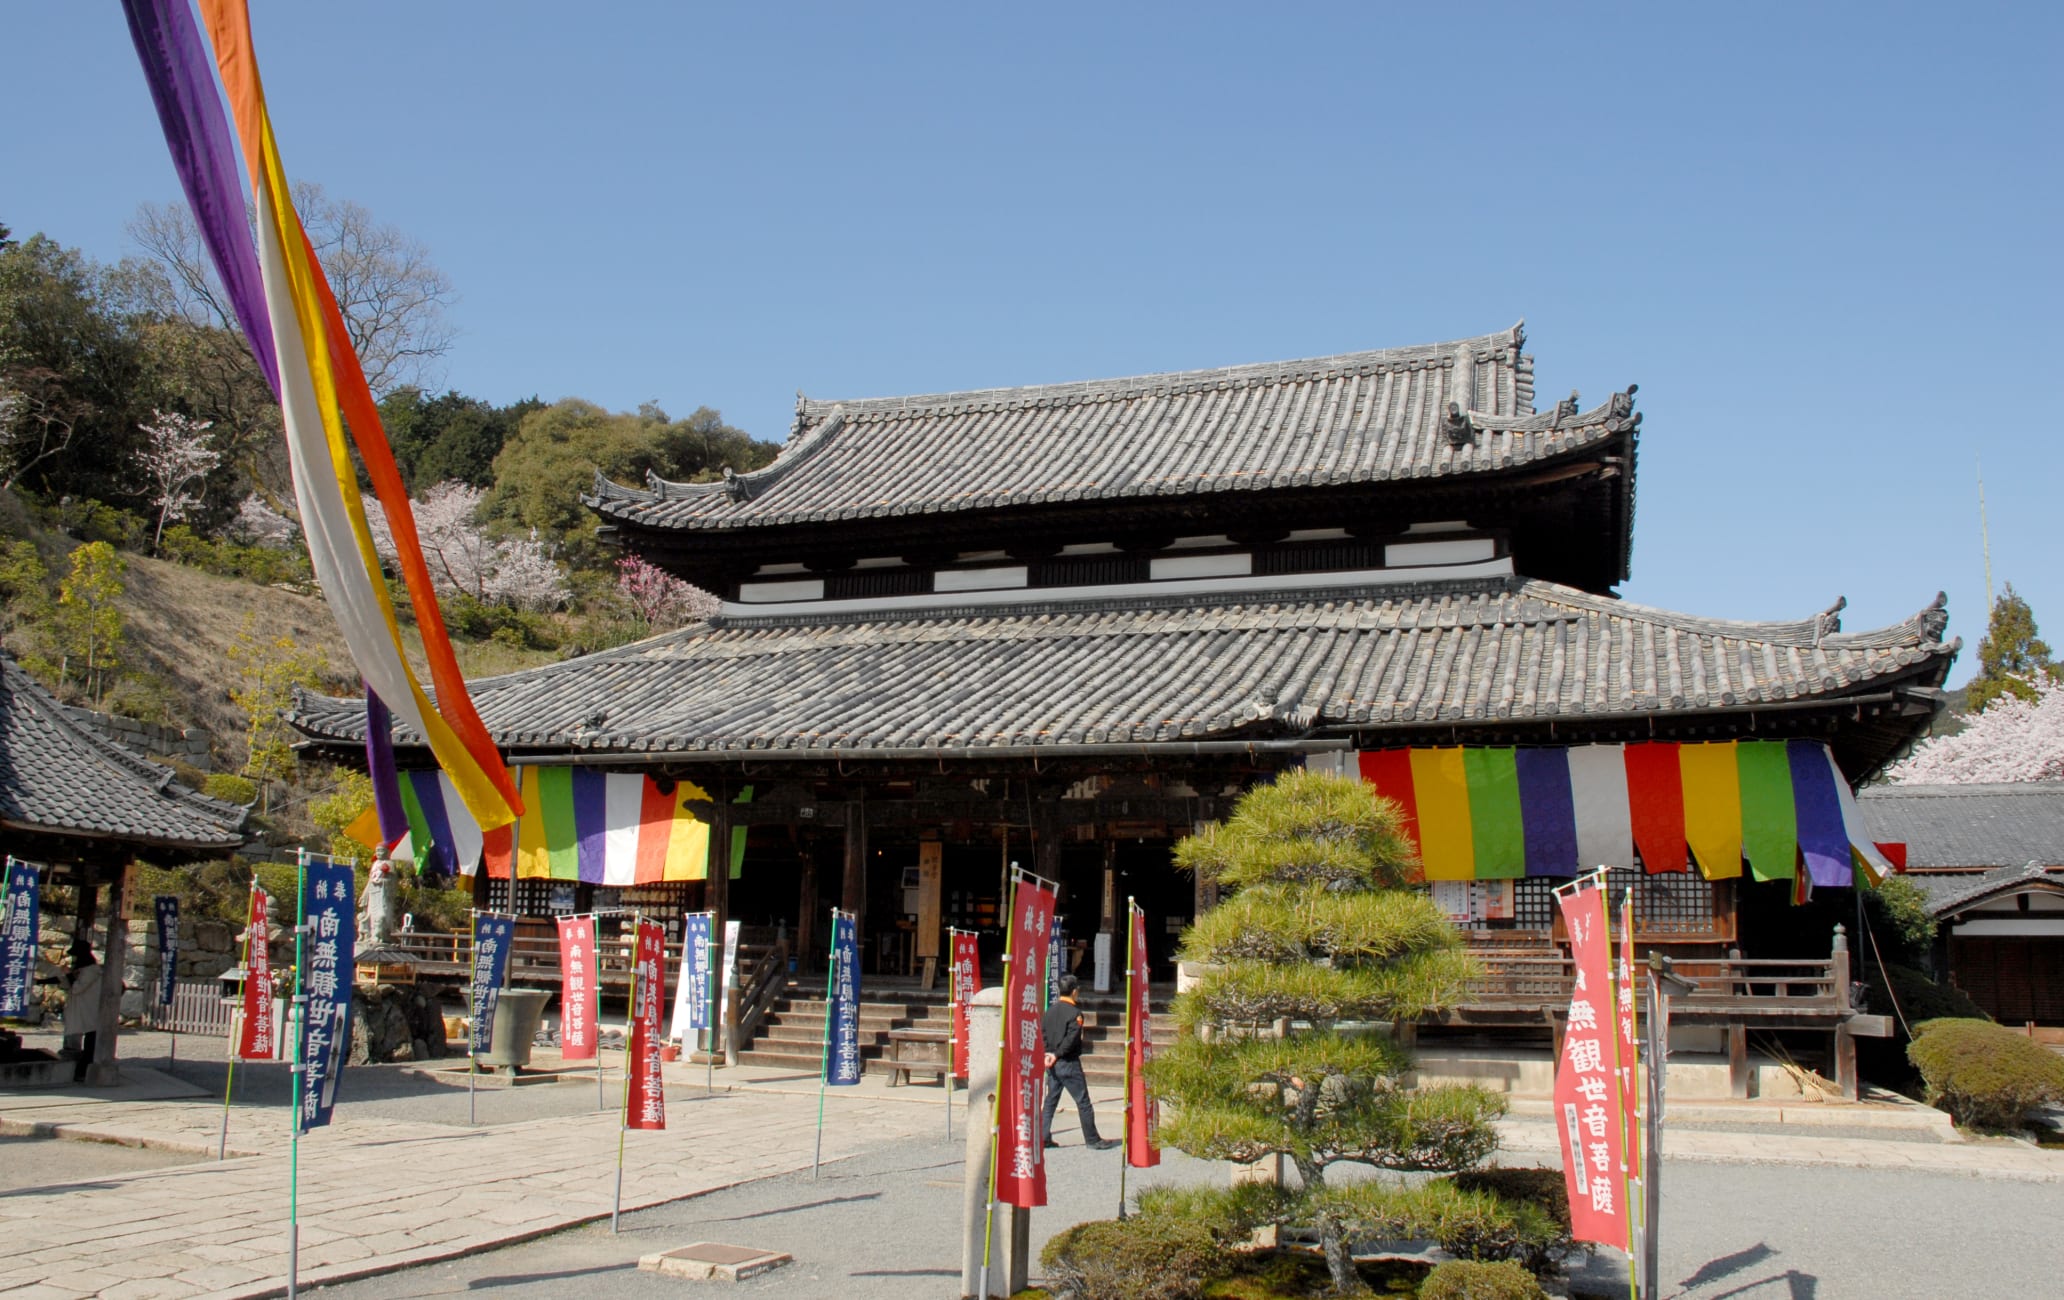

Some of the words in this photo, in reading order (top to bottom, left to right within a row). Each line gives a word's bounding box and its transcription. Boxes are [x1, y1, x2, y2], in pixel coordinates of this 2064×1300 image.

[565, 927, 586, 940] 奉納
[569, 944, 585, 1046] 南無観世音菩薩
